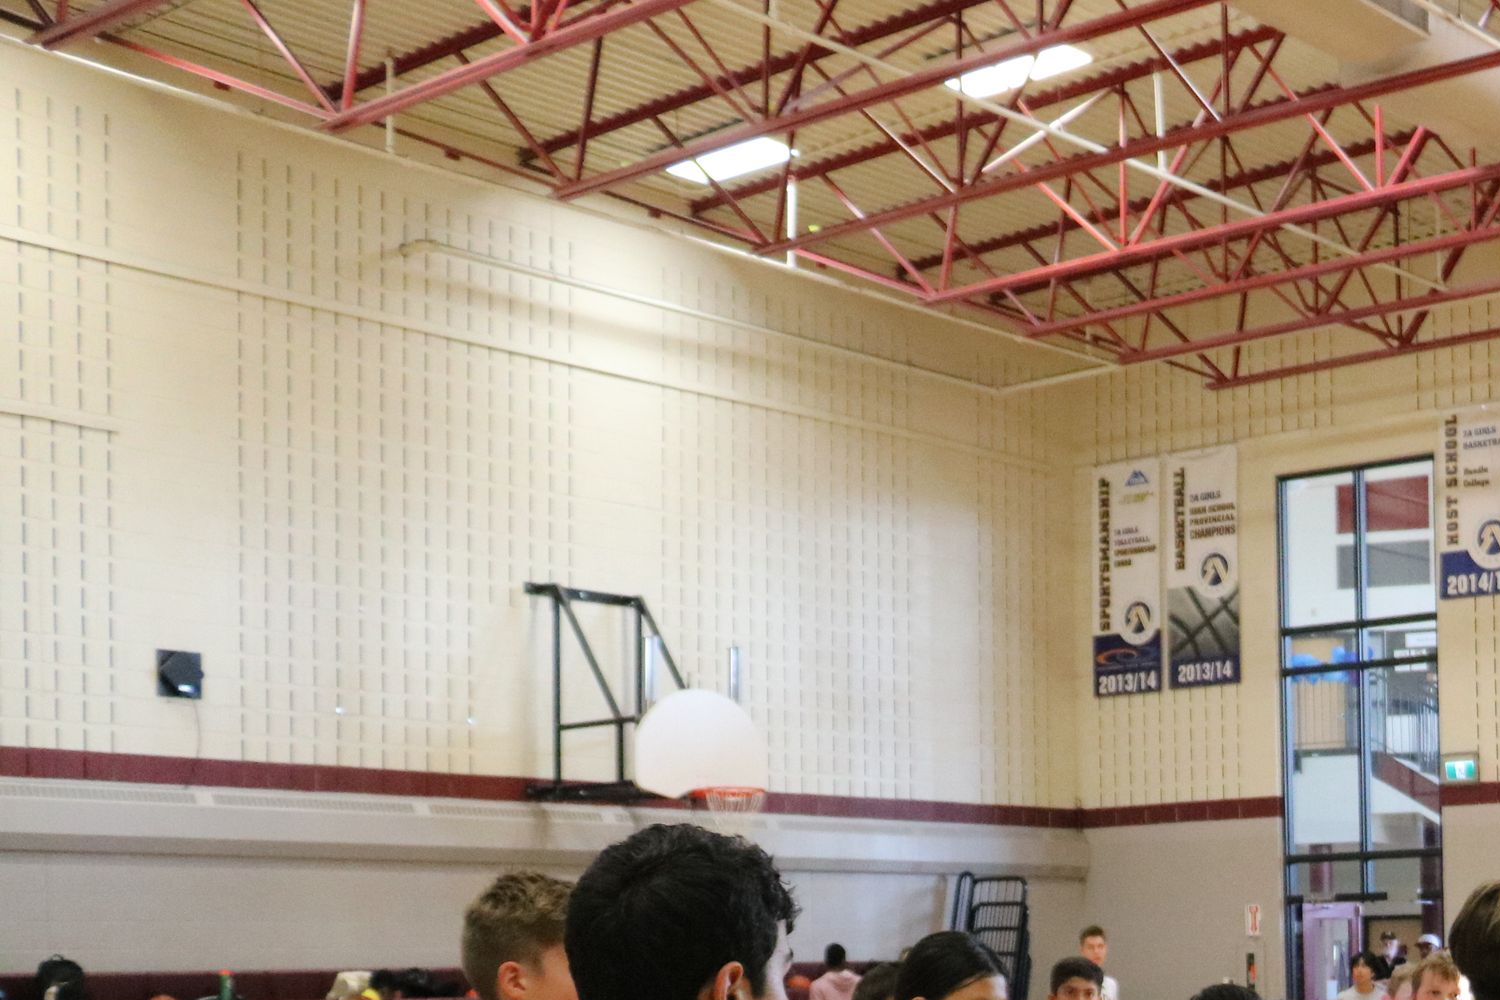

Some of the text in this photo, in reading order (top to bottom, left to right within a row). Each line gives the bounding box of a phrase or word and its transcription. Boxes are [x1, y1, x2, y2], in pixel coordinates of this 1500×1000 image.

[1445, 414, 1458, 545] HOST SCHOOL
[1174, 468, 1185, 570] BASKETBALL
[1190, 514, 1235, 526] PROVINCIAL
[1190, 524, 1236, 540] CHAMPIONS
[1099, 478, 1110, 631] SPORTSMANSHIP
[1099, 671, 1157, 694] 2013/14
[1178, 660, 1232, 683] 2013/14
